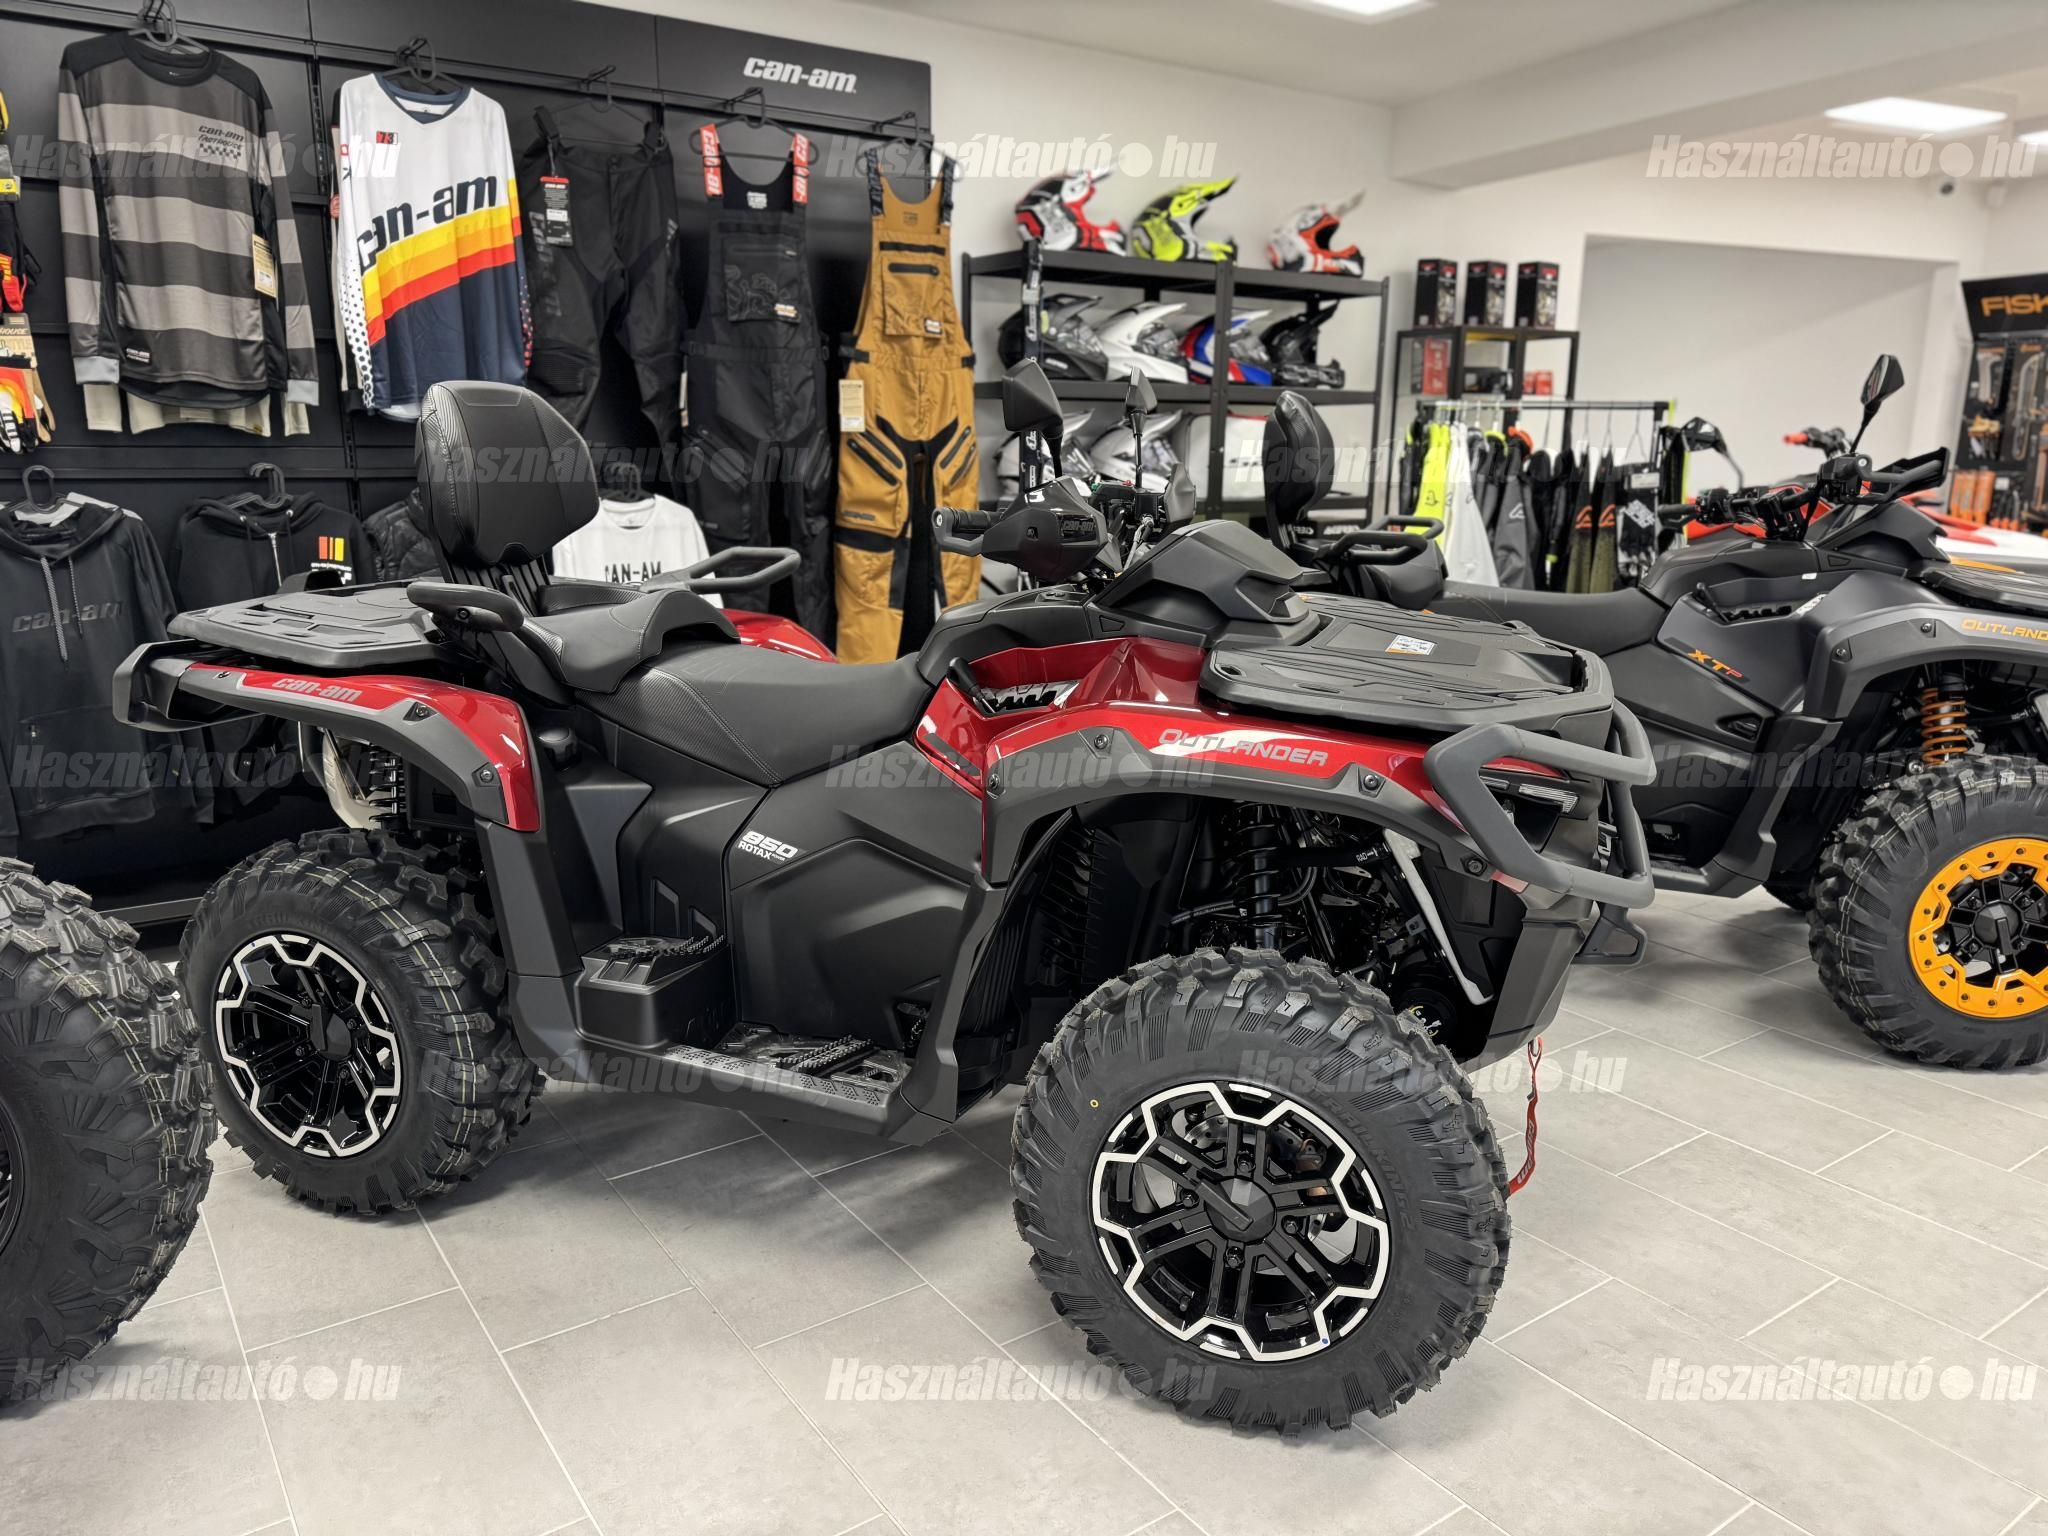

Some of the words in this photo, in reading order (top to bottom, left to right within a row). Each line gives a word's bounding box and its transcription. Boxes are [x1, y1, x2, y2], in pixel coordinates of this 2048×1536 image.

[1158, 728, 1329, 767] OUTLANDER
[738, 840, 772, 860] ROTAX
[742, 830, 798, 859] 850
